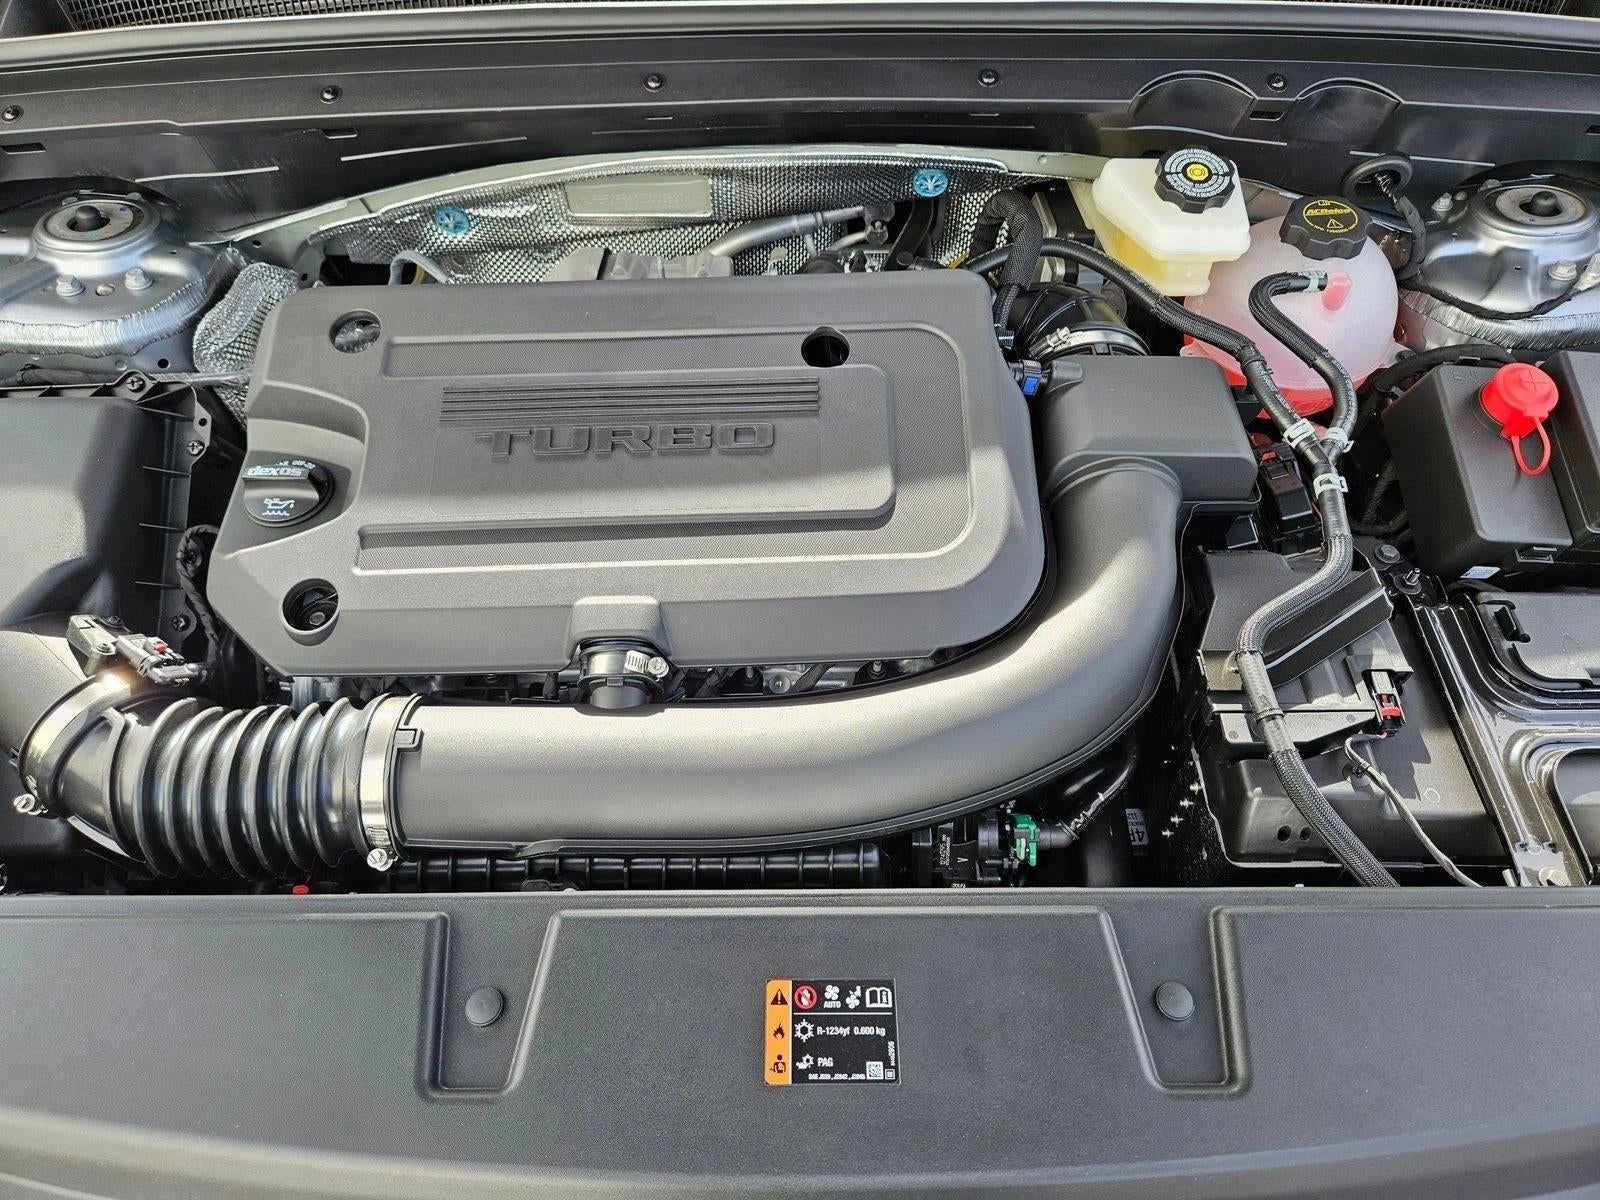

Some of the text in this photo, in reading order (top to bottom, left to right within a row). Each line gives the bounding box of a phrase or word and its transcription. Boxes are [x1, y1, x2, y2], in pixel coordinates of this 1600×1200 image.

[474, 421, 775, 457] TURBO
[247, 465, 303, 477] dexos
[823, 1000, 842, 1009] AUTO
[816, 1026, 886, 1037] R-1234yf 0.600 kg
[817, 1057, 834, 1067] PAG
